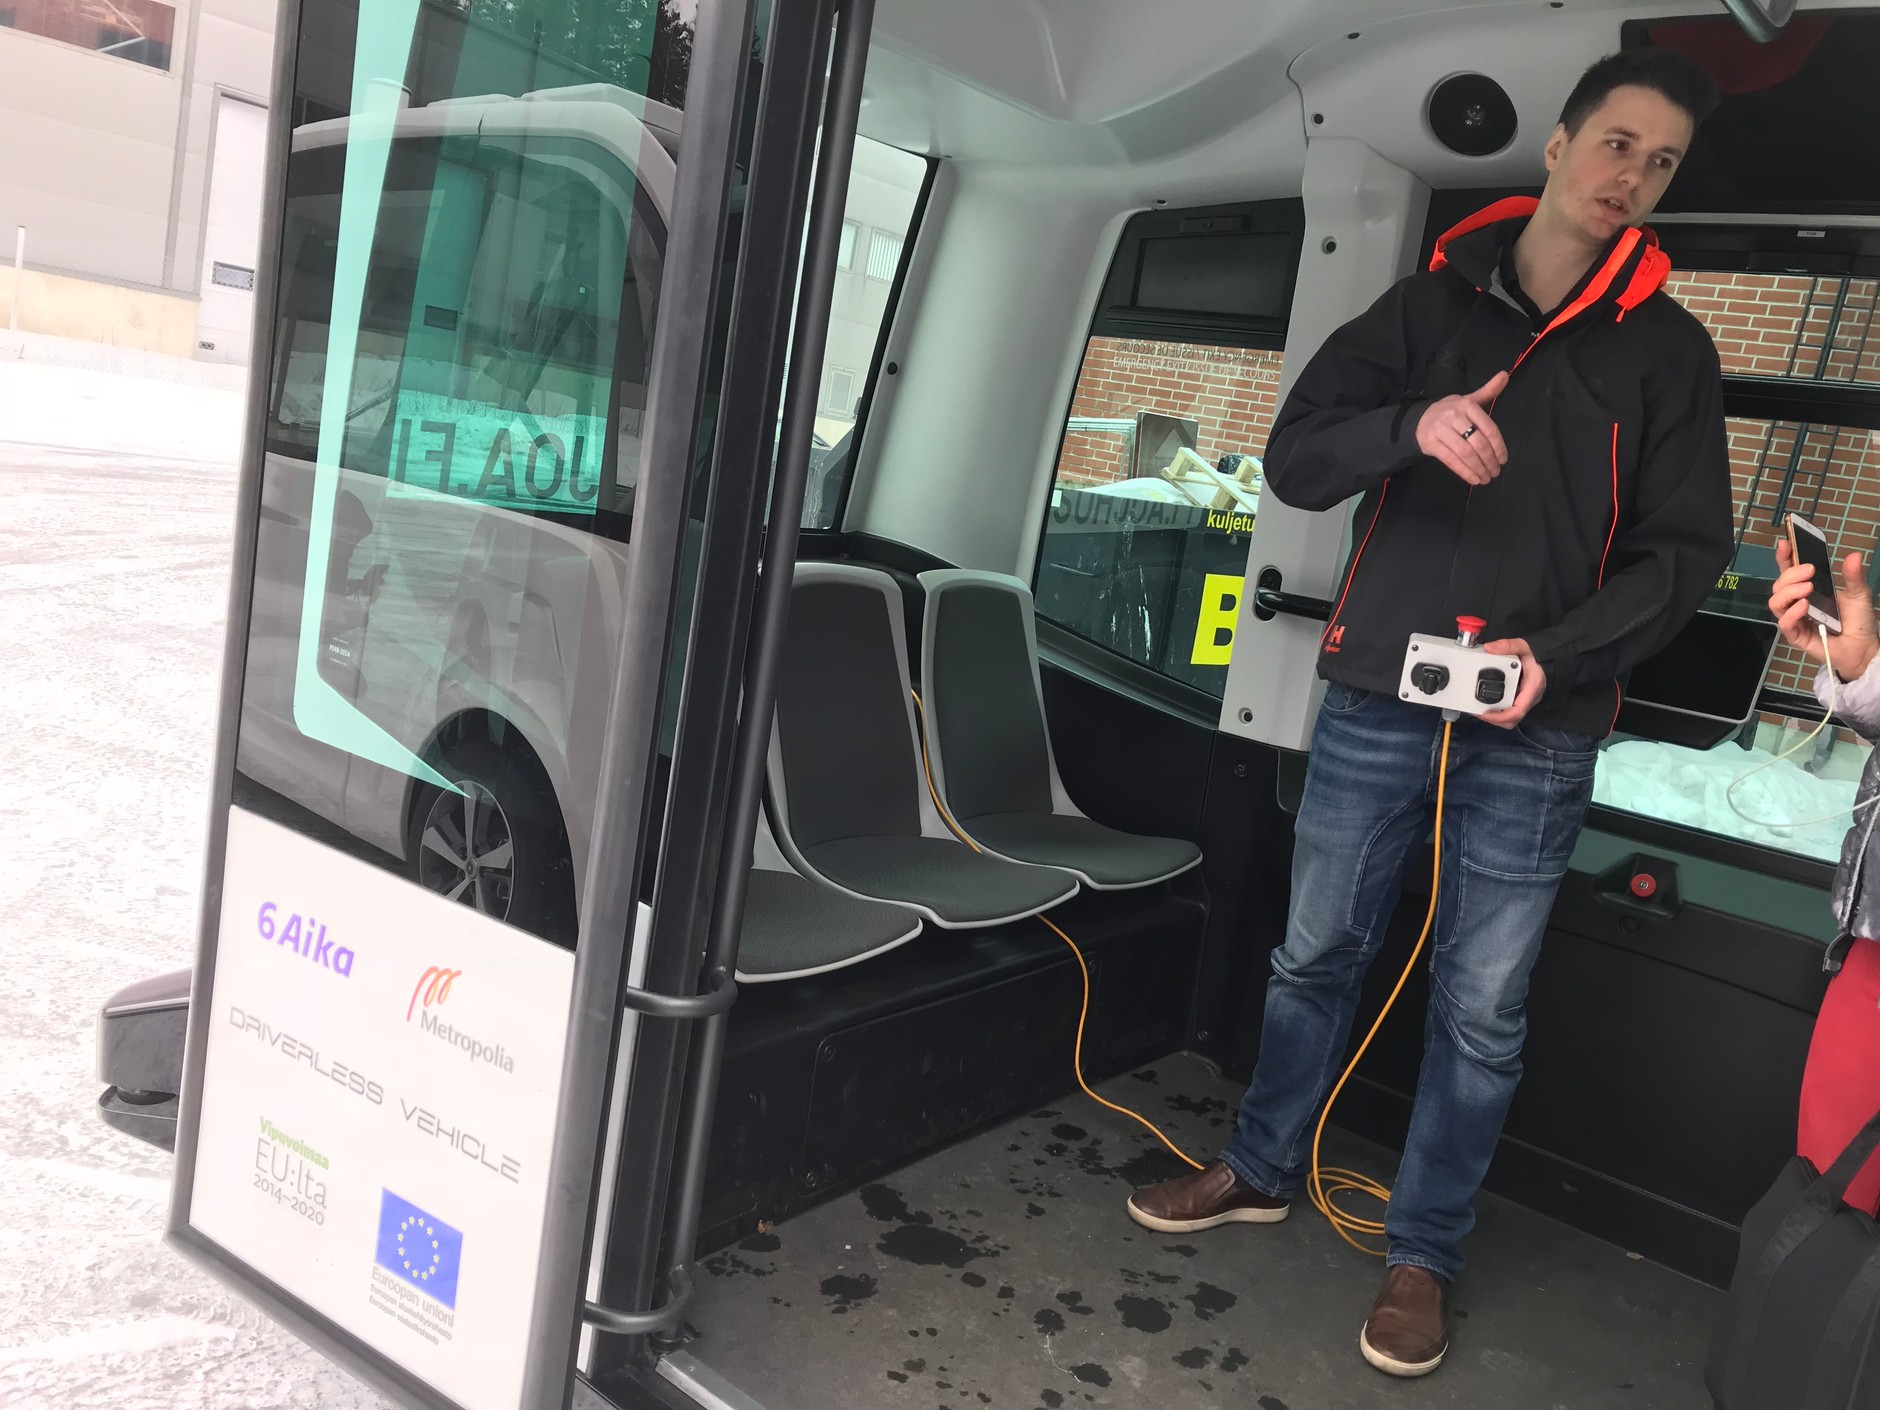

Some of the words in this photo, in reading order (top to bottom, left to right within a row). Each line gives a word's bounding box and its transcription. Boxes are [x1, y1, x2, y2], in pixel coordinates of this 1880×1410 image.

[1113, 356, 1165, 371] EMERGENCY
[1233, 367, 1276, 381] SECOURS
[1724, 575, 1740, 590] 782
[420, 1009, 515, 1074] Metropolia
[229, 1006, 384, 1105] DRIVERLESS
[400, 1098, 521, 1184] VEHICLE
[256, 1137, 328, 1210] EU:lta
[260, 1116, 330, 1171] Vipuvoimaa
[372, 1265, 420, 1307] Euroopan
[422, 1299, 455, 1329] unioni
